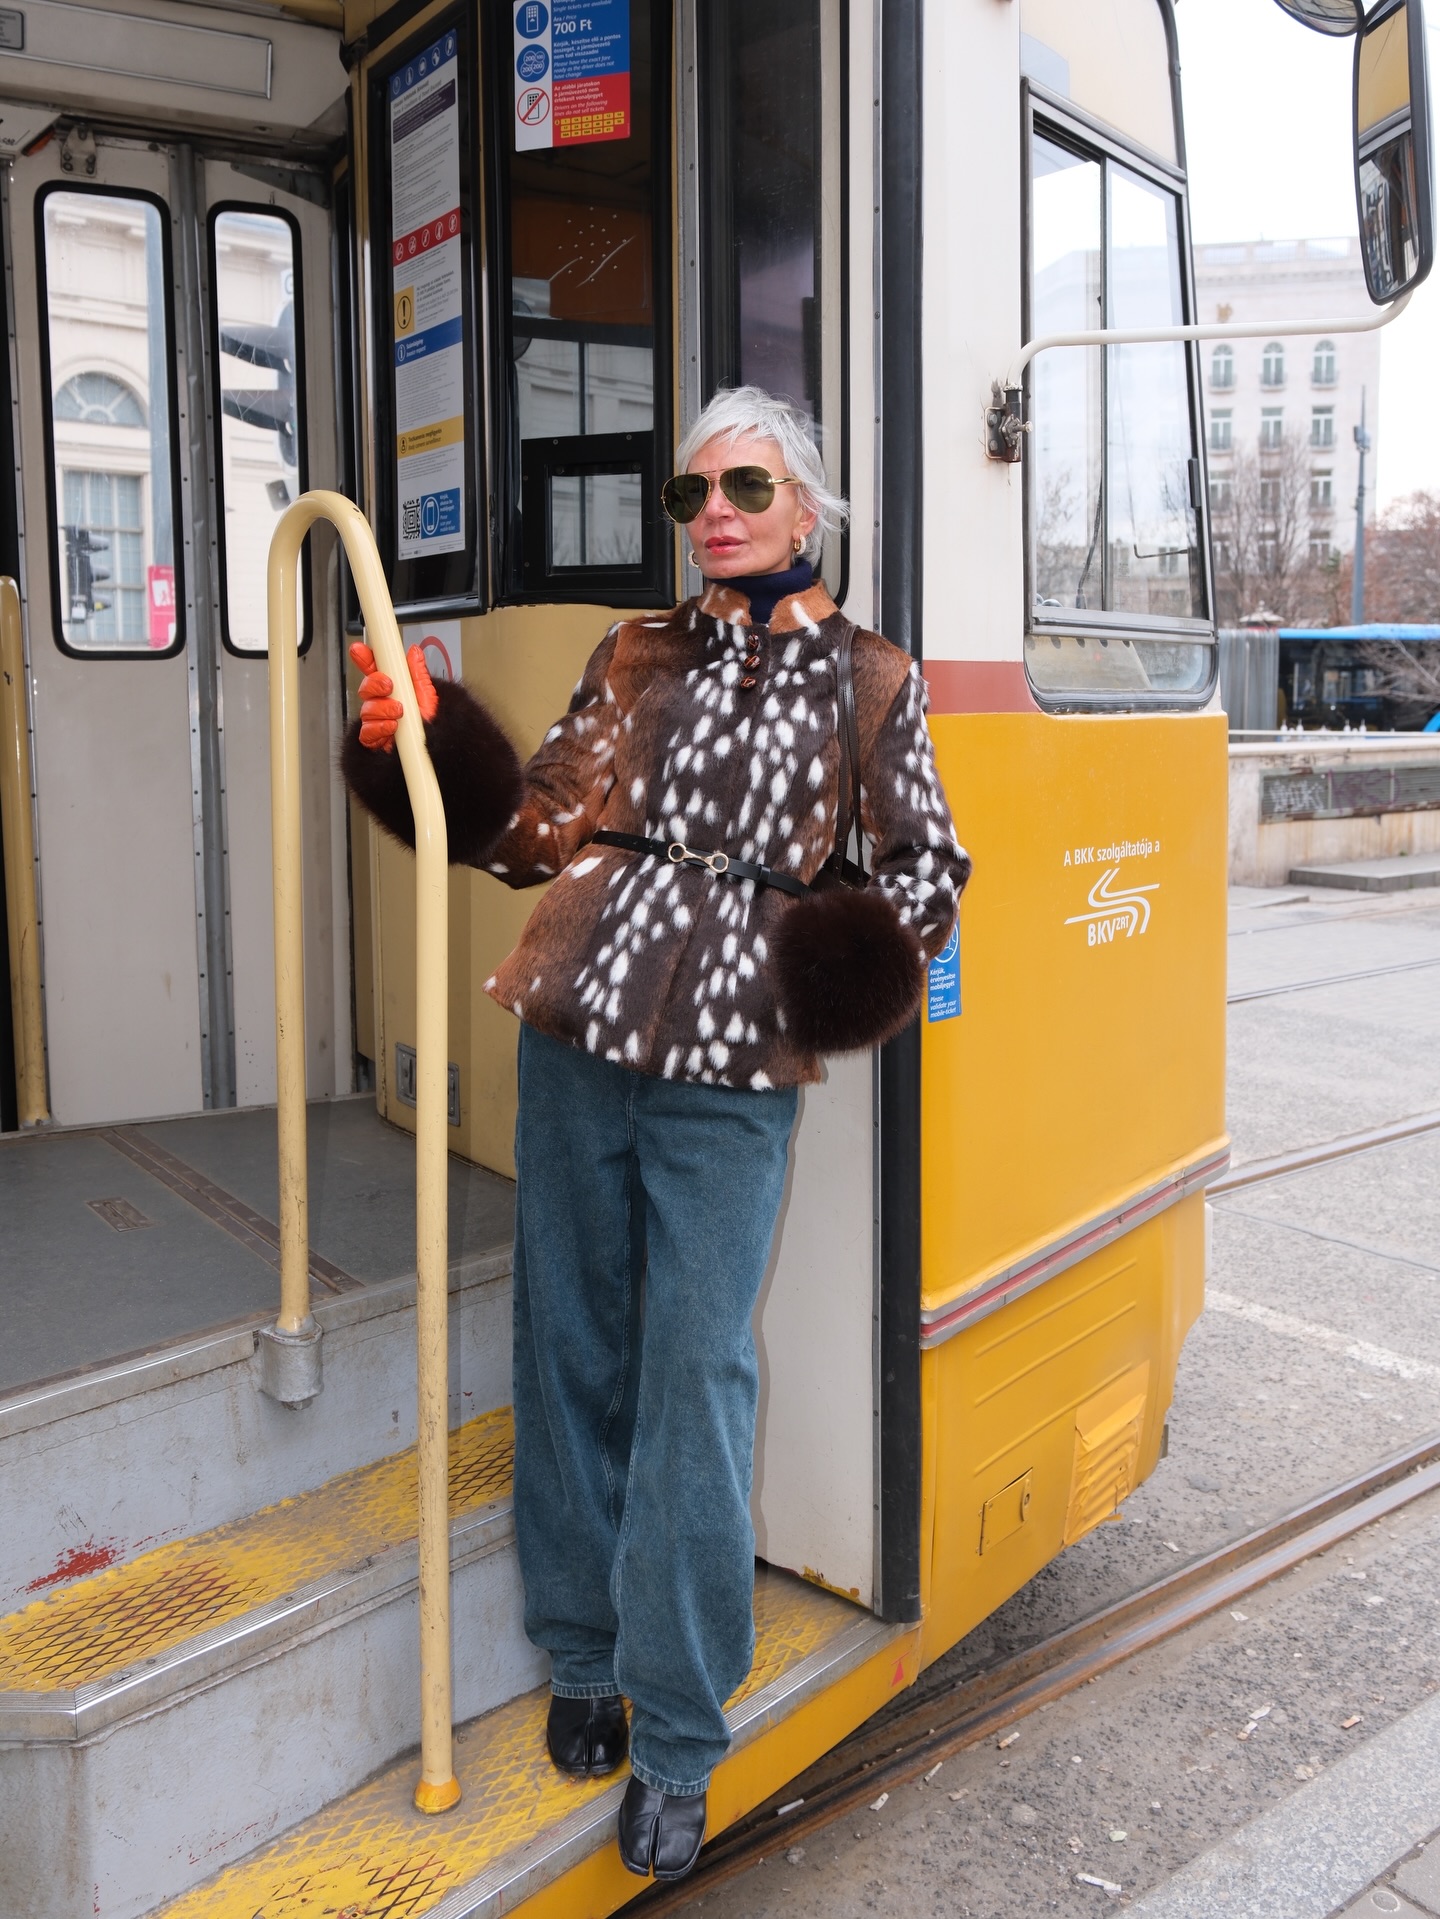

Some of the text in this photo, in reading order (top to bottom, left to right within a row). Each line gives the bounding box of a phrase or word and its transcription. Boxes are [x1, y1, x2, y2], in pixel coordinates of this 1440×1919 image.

[554, 19, 592, 35] 700 Ft
[1063, 838, 1160, 866] A BKK szolgáltatója a
[1088, 916, 1130, 947] BKV ZRT
[930, 968, 945, 976] Kérjük,
